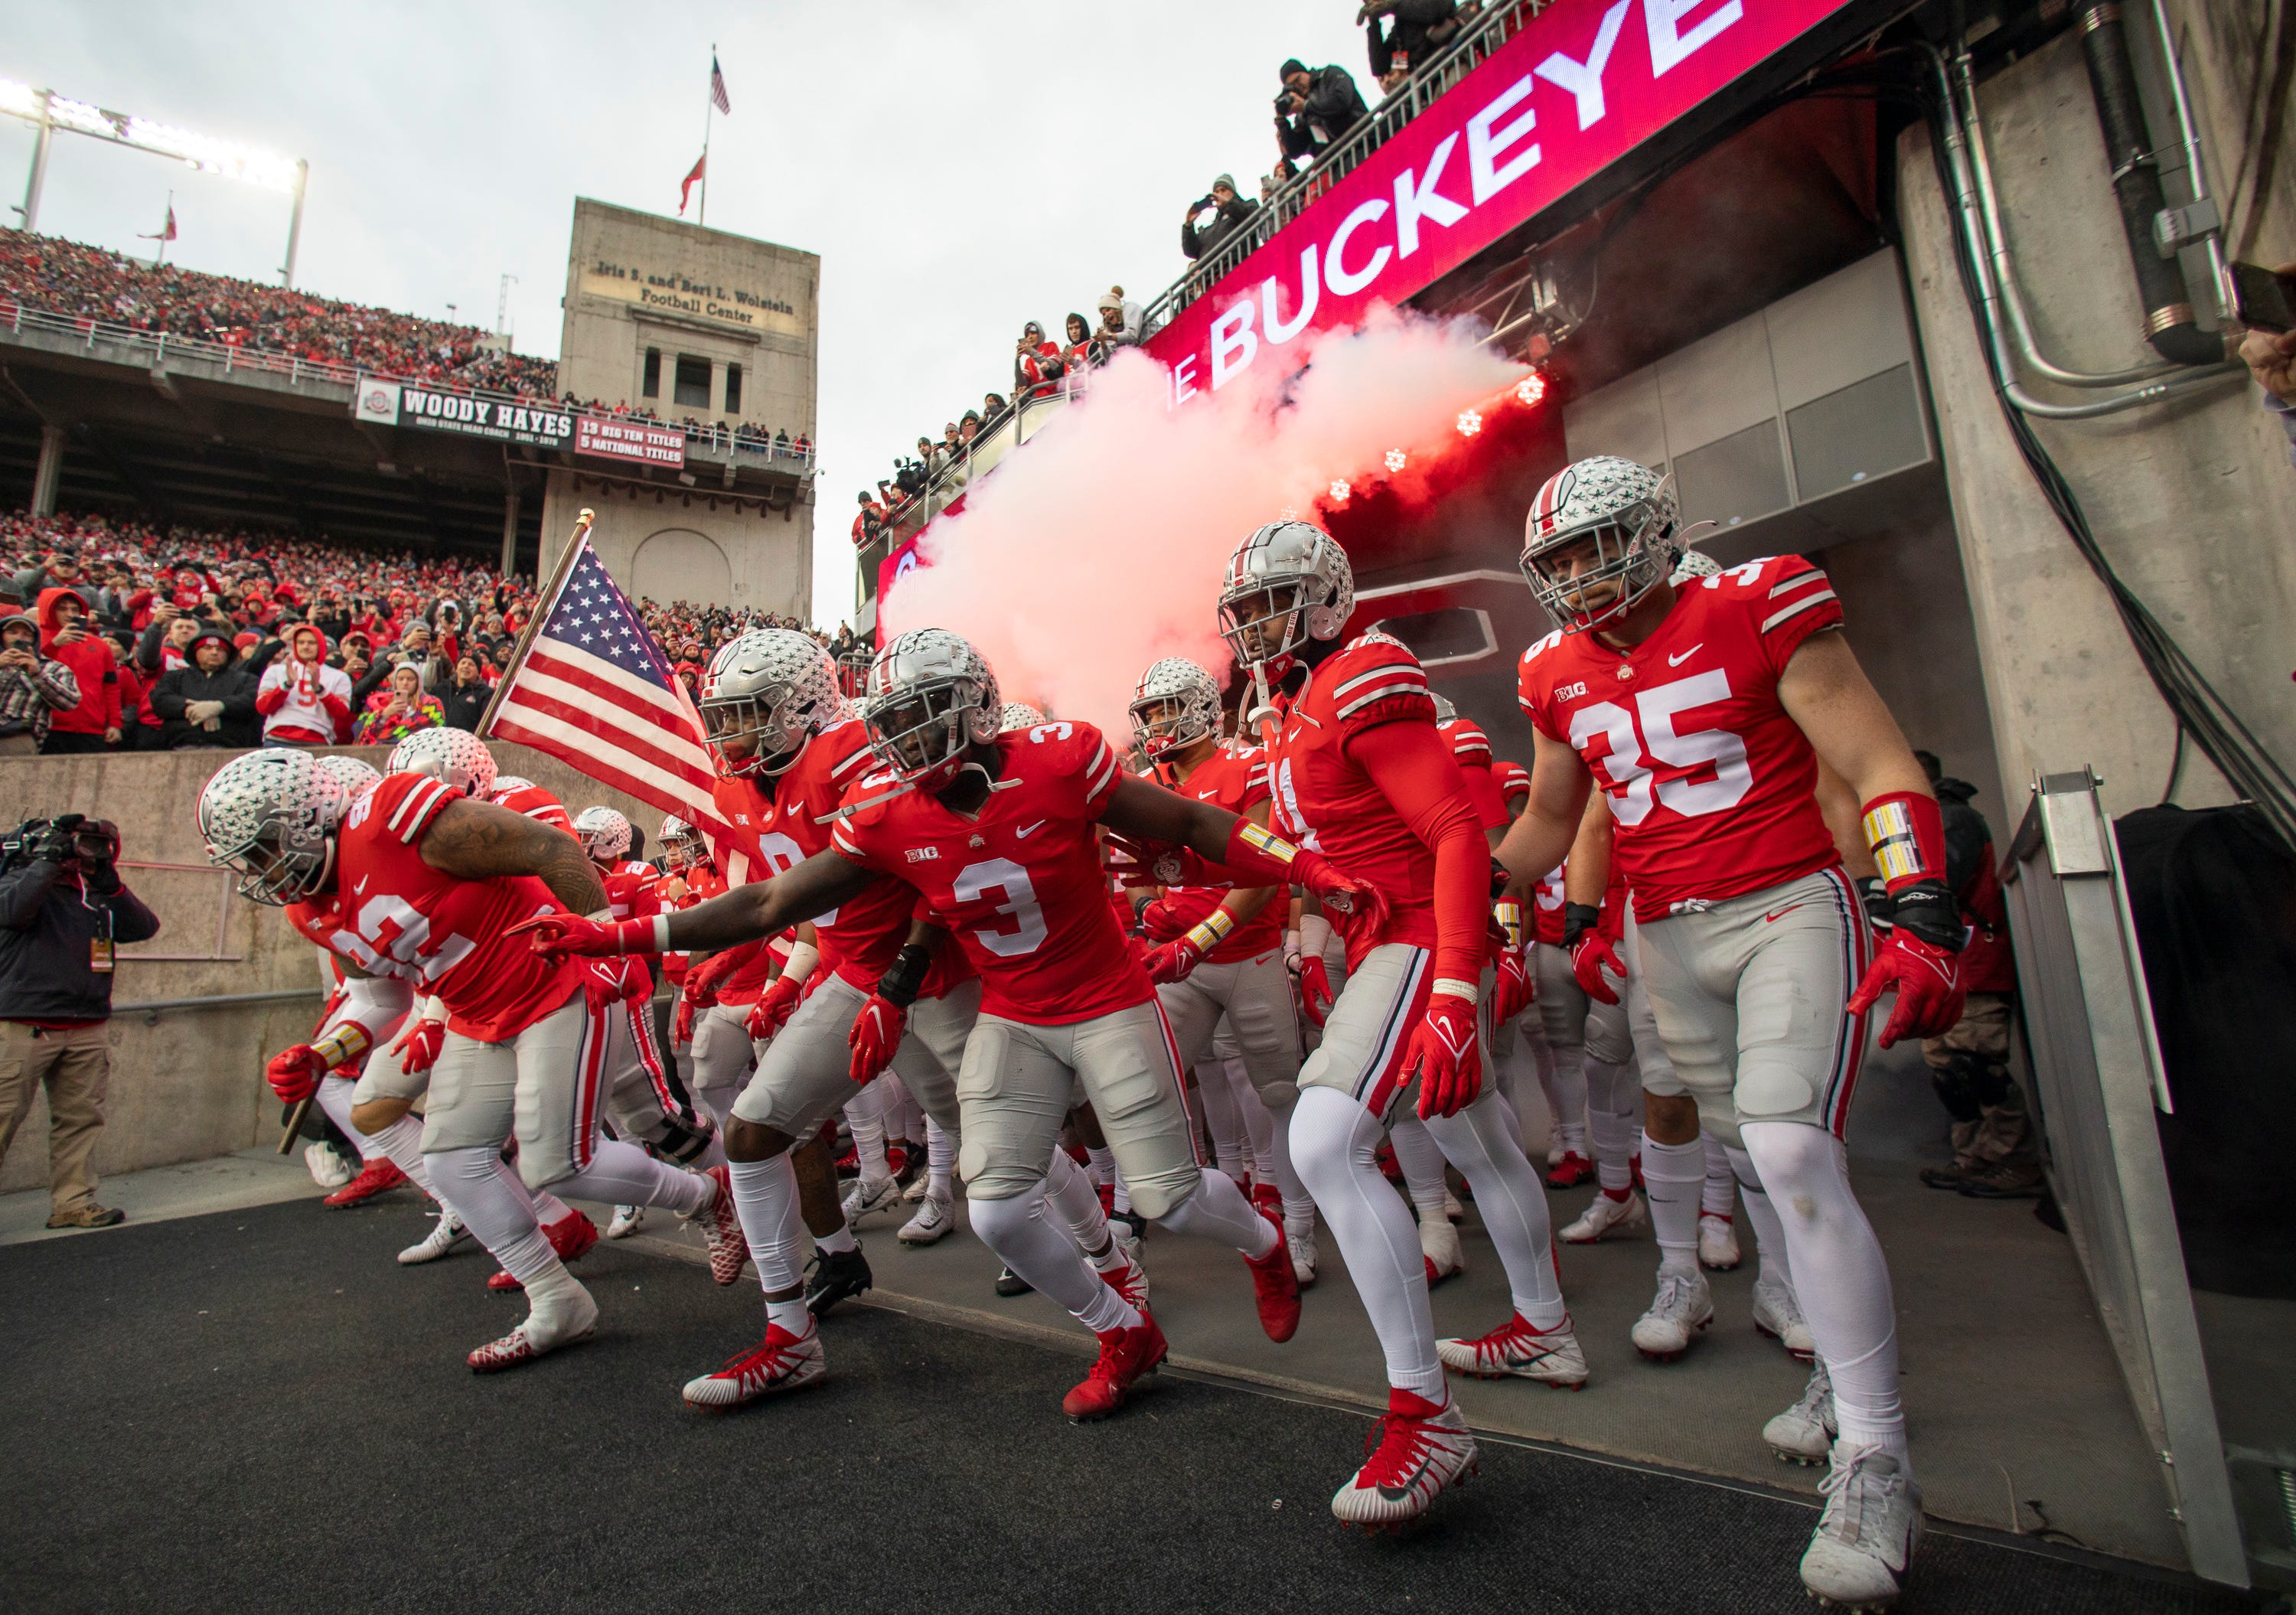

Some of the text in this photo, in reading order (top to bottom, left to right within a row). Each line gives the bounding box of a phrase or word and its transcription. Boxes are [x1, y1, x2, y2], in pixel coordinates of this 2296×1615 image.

[598, 260, 625, 278] Iris
[631, 268, 644, 282] S.
[648, 276, 674, 289] and
[681, 278, 711, 298] Bert
[716, 286, 731, 301] L.
[641, 288, 753, 323] Football Center
[403, 389, 491, 424] WOODY
[497, 404, 572, 438] HAYES
[416, 416, 437, 428] OHIO
[438, 419, 461, 432] STATE
[462, 423, 484, 435] HEAD
[484, 426, 510, 439] COACH
[580, 436, 682, 463] 5 NATIONAL TITLES
[582, 420, 683, 449] 13 BIG TEN TITLES
[1286, 625, 1294, 638] OHIO
[297, 679, 317, 707] 5
[1568, 667, 1753, 826] 35
[953, 856, 1049, 957] 3
